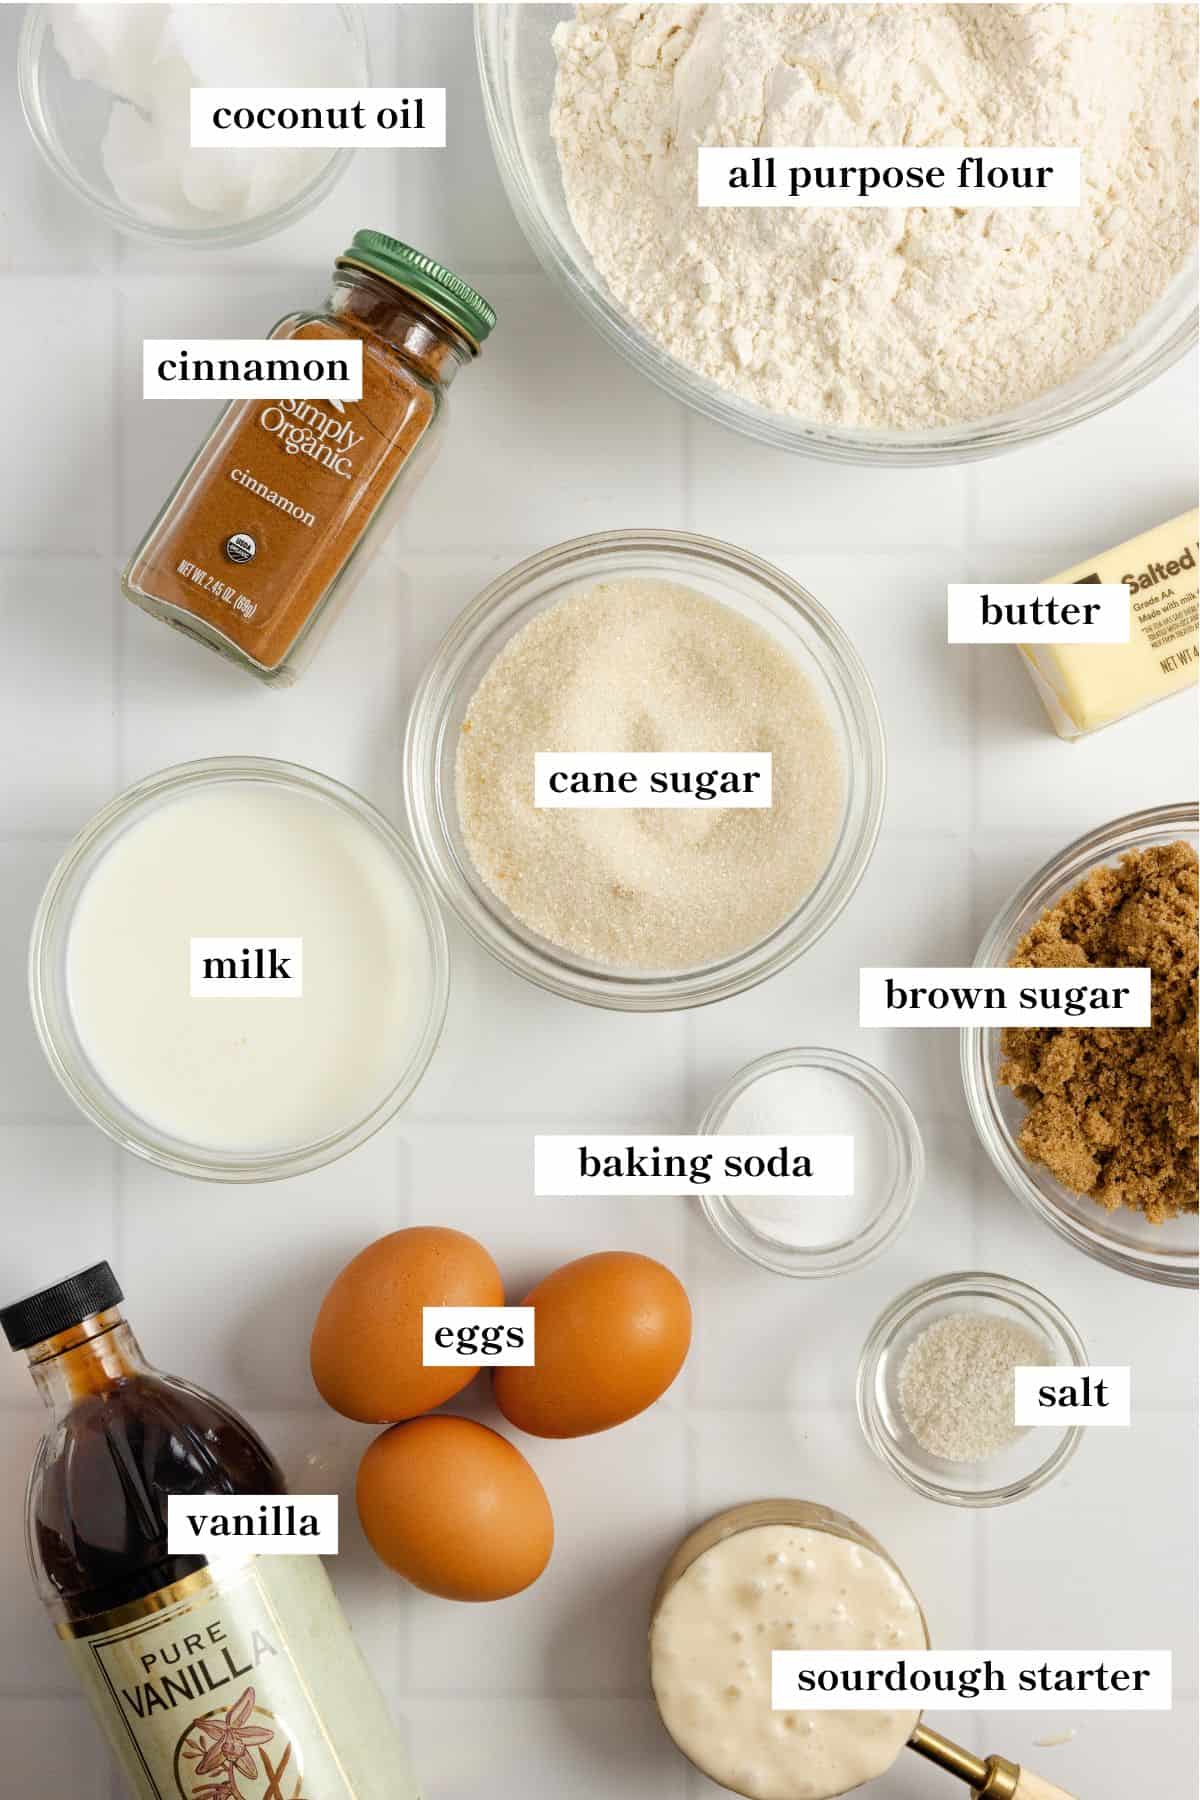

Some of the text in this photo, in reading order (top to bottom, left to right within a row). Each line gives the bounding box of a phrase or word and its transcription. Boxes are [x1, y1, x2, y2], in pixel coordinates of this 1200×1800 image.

[230, 468, 316, 527] cinnamon
[177, 559, 195, 577] NET
[1121, 547, 1196, 595] Salted
[1133, 588, 1175, 612] Grade AA
[1138, 610, 1161, 624] Made
[1162, 600, 1179, 613] with
[1160, 655, 1178, 673] NET
[1176, 648, 1192, 666] WT
[140, 1620, 227, 1673] PURE
[122, 1629, 278, 1718] VANILLA
